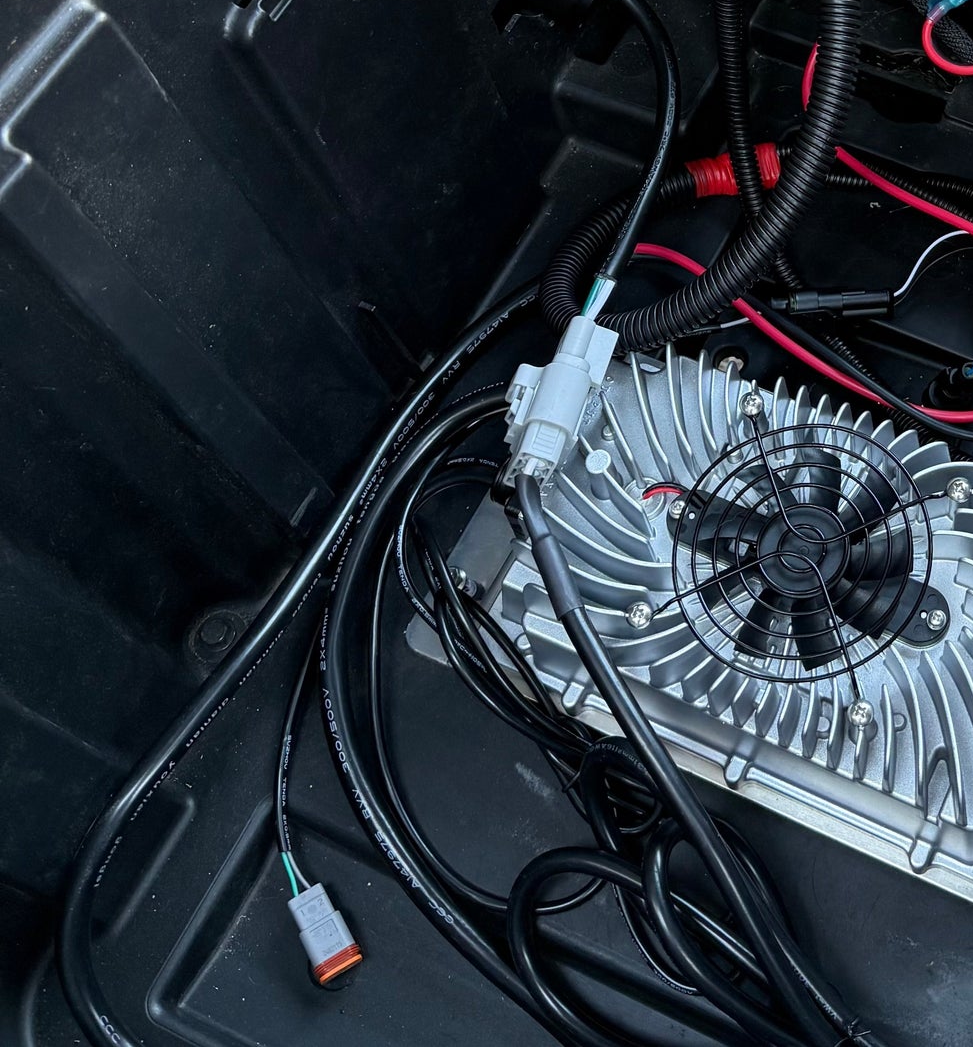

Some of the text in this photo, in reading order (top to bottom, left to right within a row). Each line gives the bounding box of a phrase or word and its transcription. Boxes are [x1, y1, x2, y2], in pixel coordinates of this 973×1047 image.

[439, 359, 461, 384] RVV
[389, 389, 437, 451] 300/500V
[325, 514, 355, 562] suzhou
[282, 734, 292, 769] SUZHOU
[322, 687, 351, 773] 300/500V
